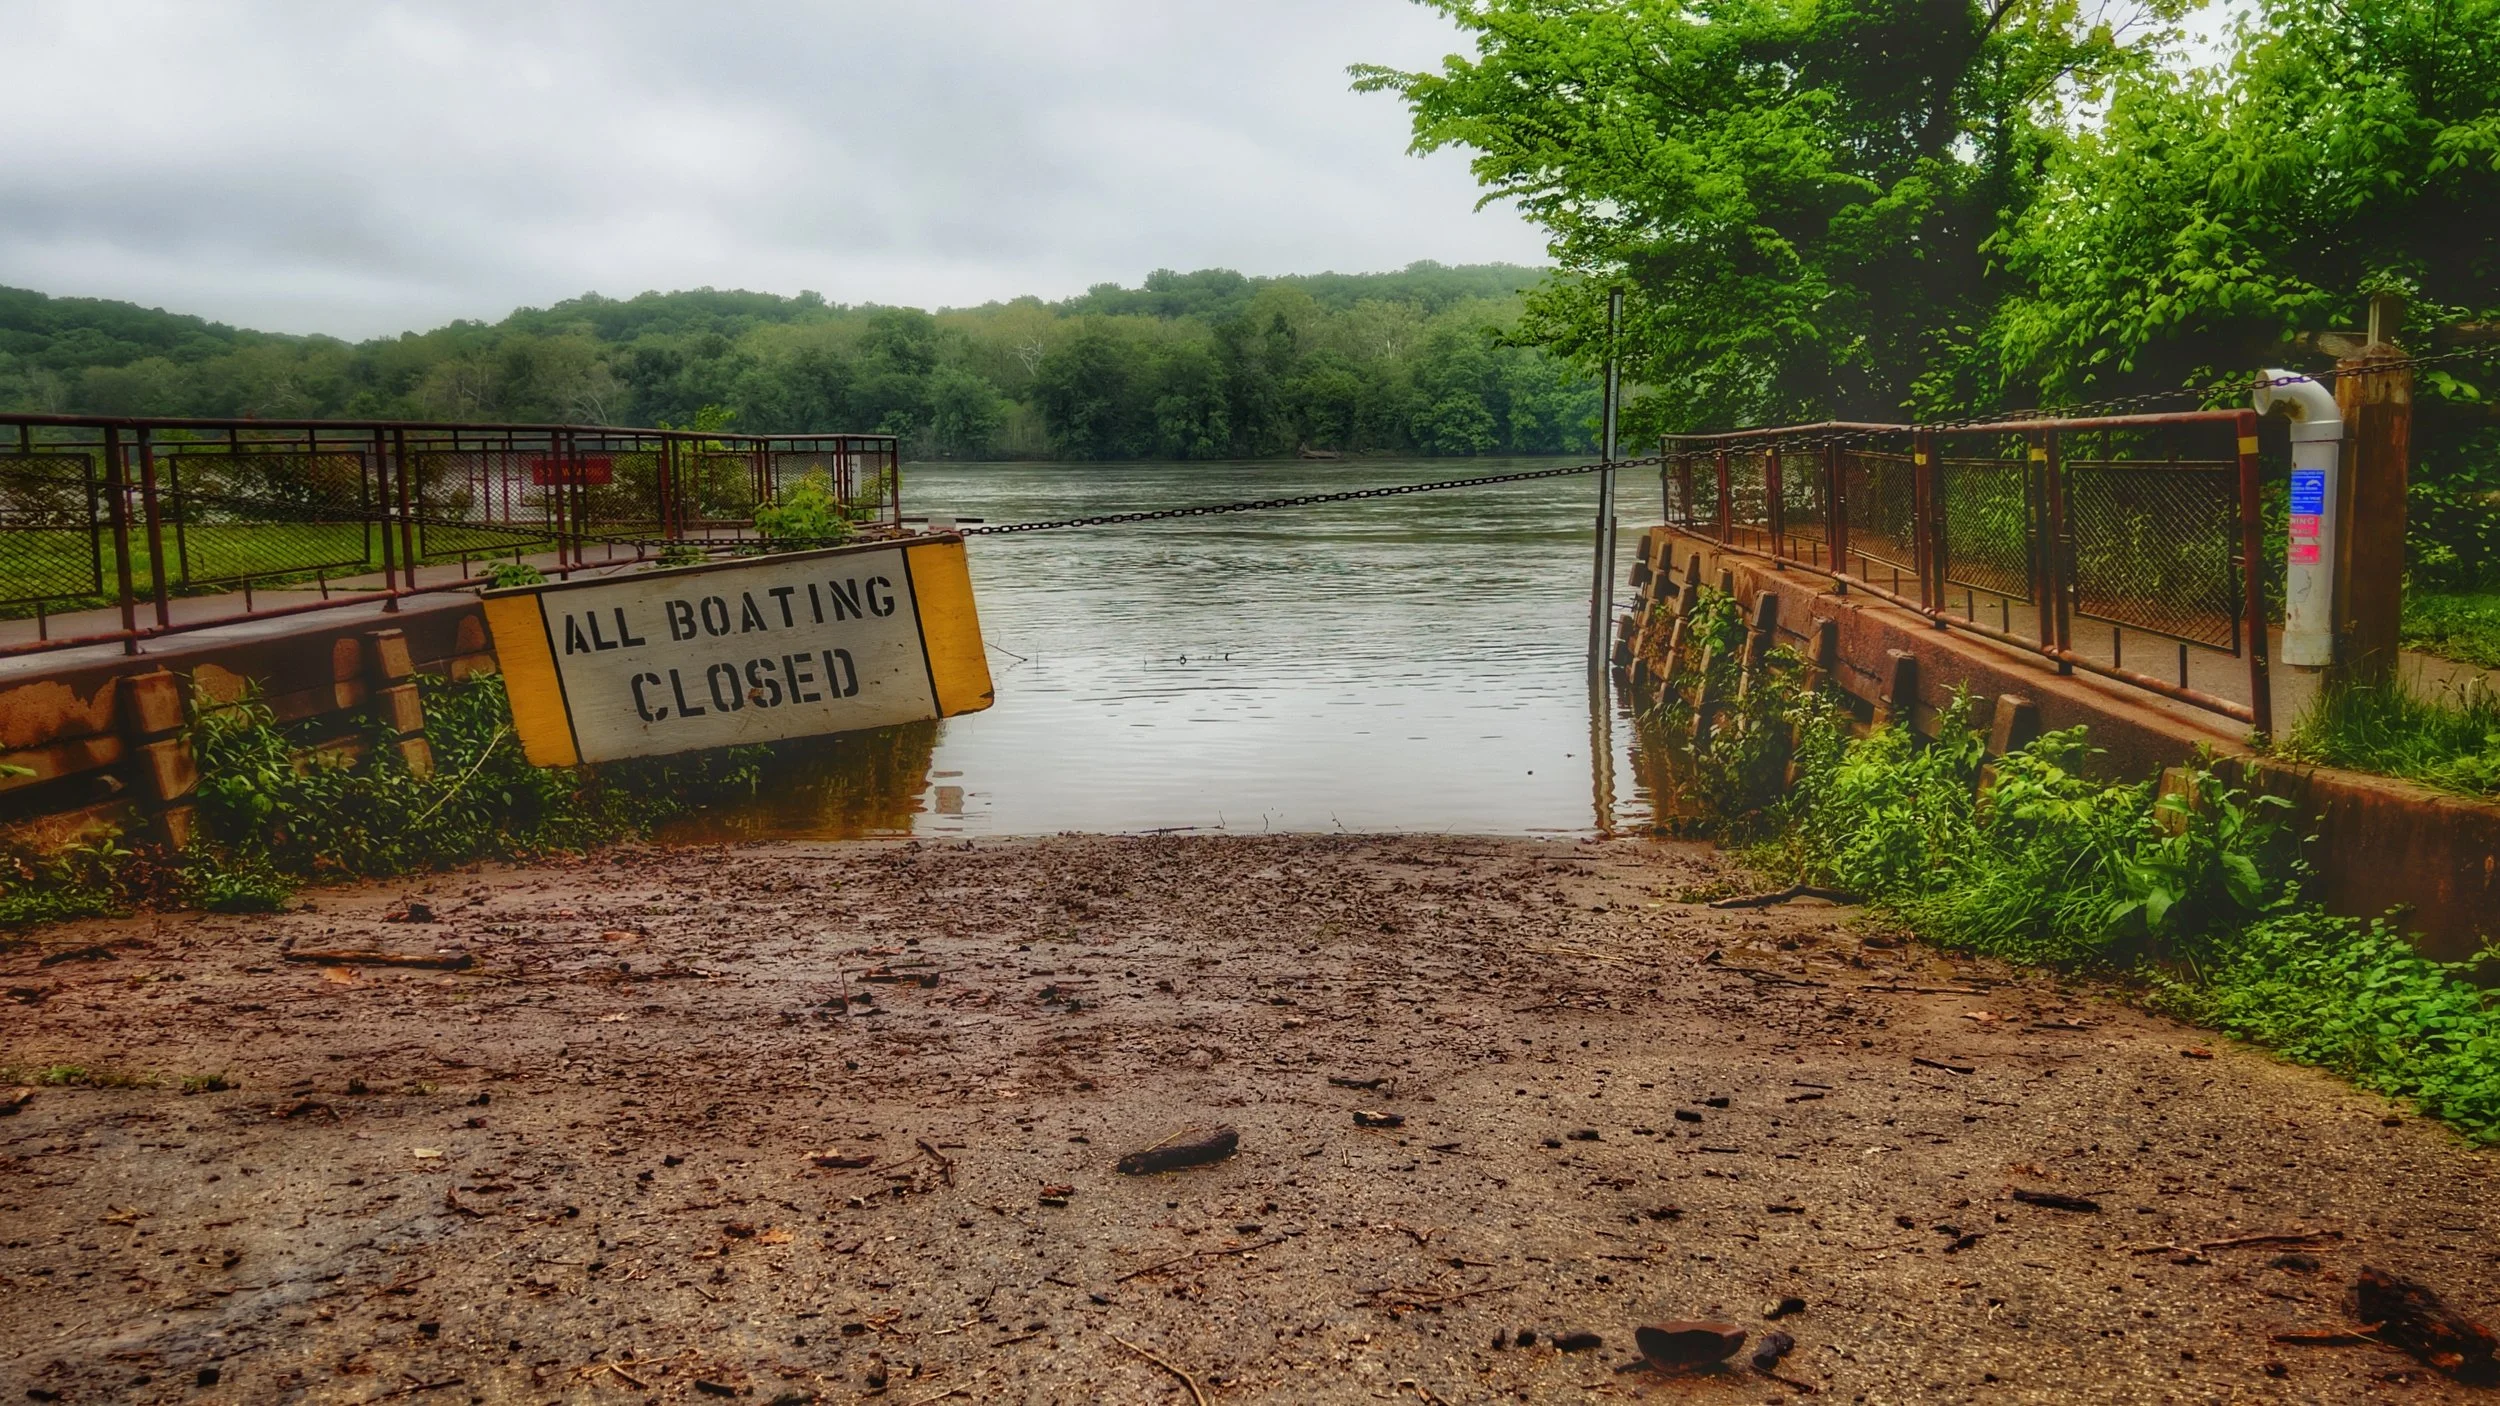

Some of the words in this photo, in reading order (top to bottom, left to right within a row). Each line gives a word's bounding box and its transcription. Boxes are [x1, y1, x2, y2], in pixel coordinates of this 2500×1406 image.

[565, 607, 646, 656] ALL
[665, 575, 896, 642] BOATING
[630, 648, 860, 723] CLOSED
